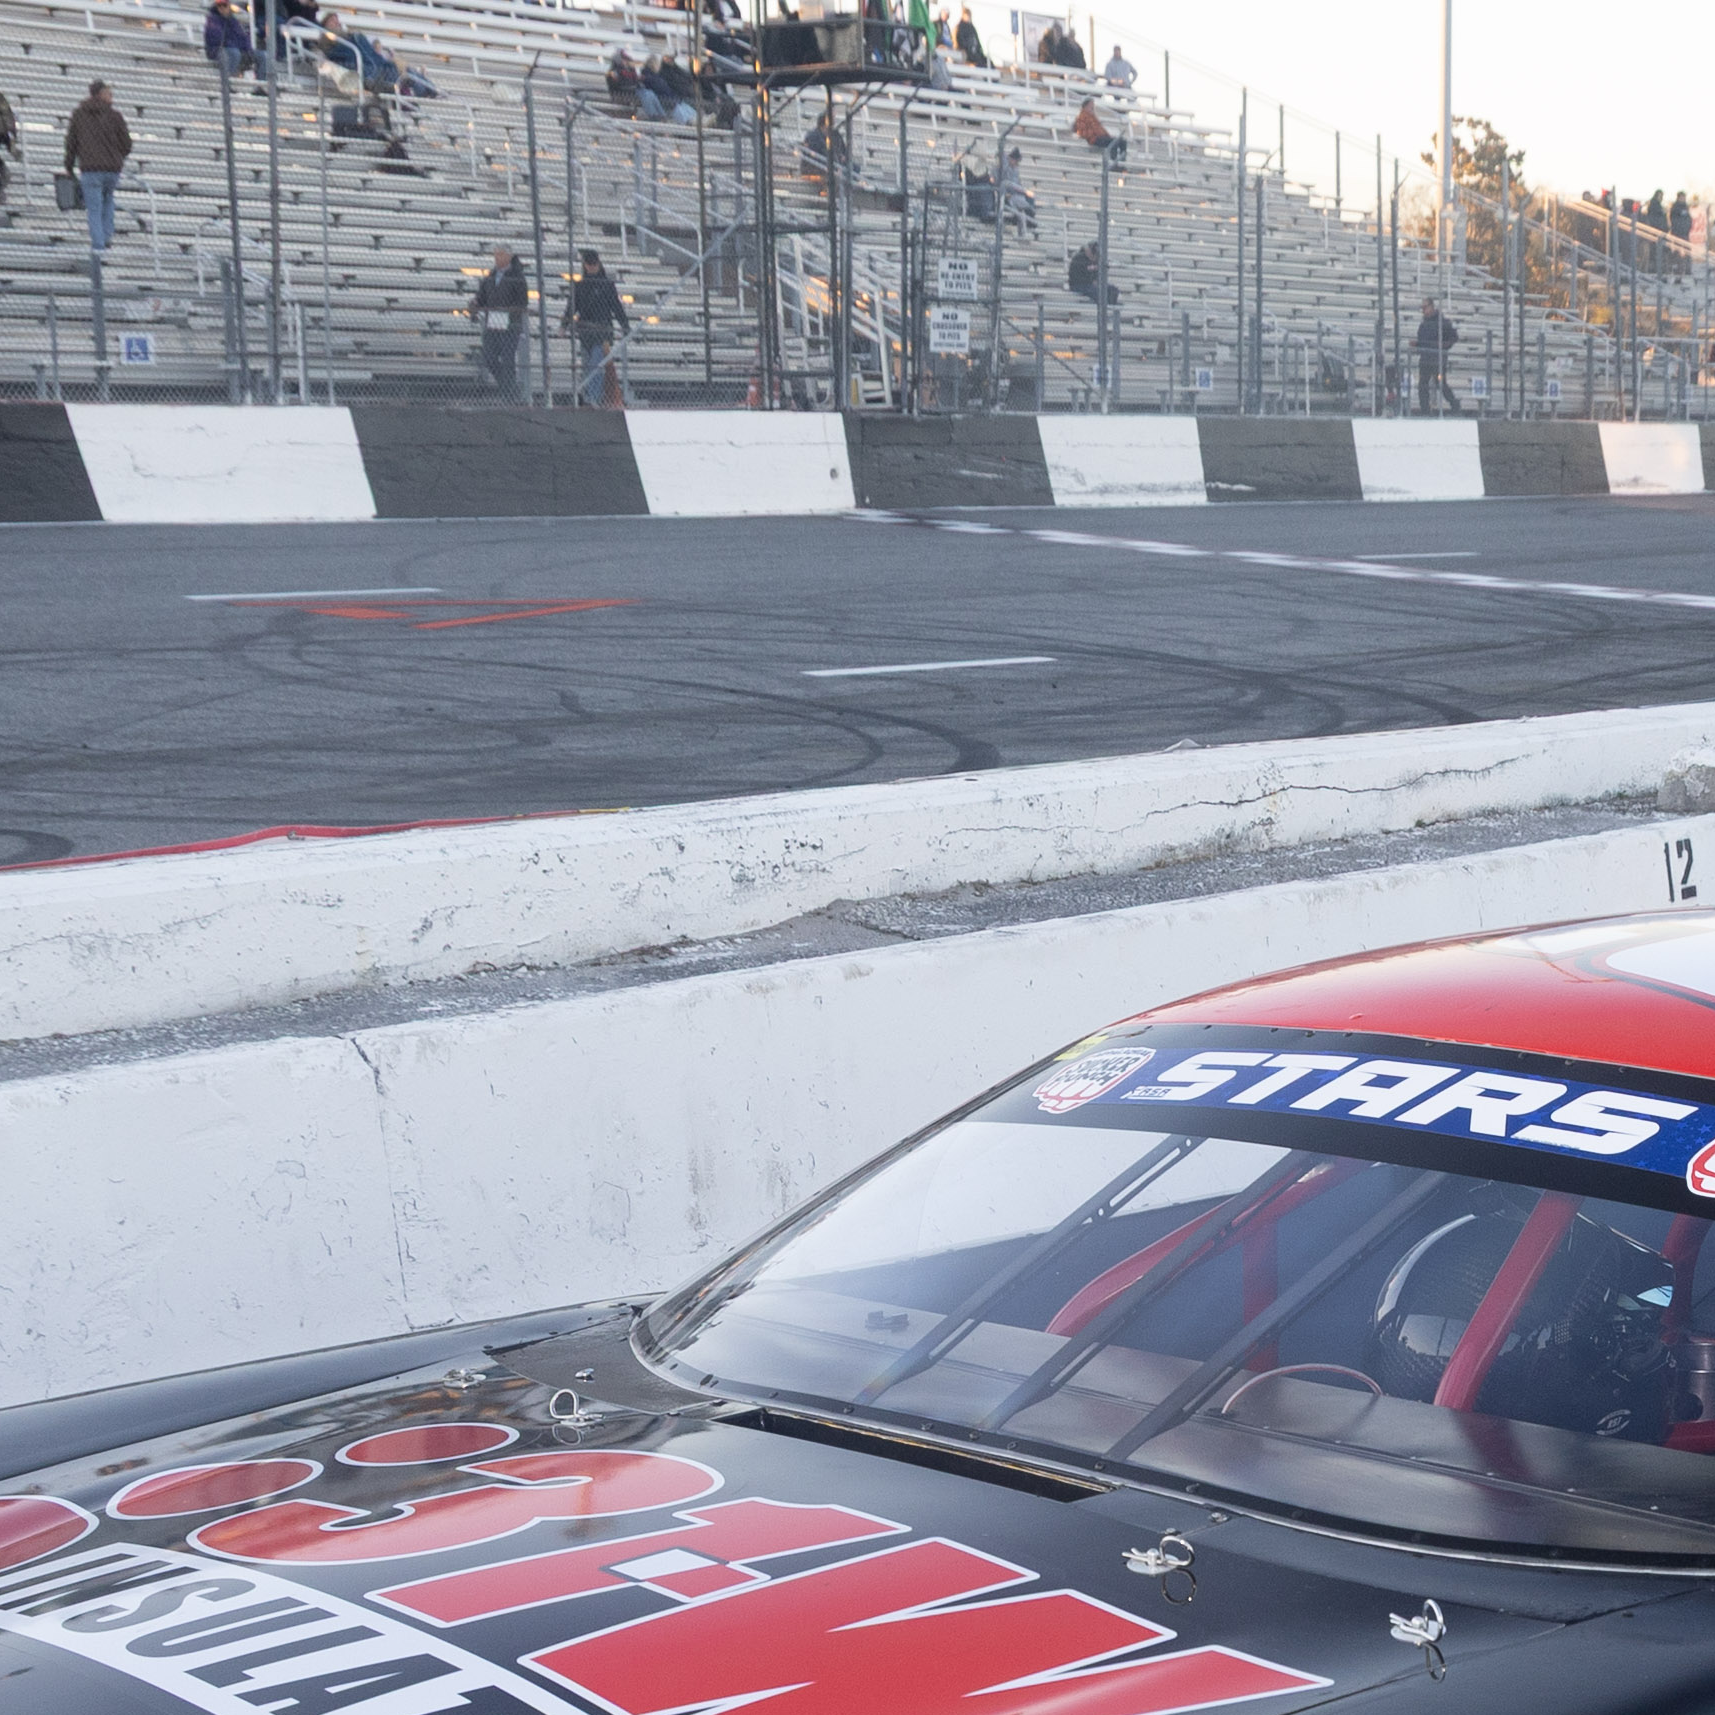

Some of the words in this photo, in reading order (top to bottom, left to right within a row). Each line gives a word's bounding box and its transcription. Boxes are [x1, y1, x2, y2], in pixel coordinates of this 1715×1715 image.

[942, 312, 958, 320] NO
[1664, 838, 1697, 903] 12
[1133, 1051, 1699, 1155] STARS
